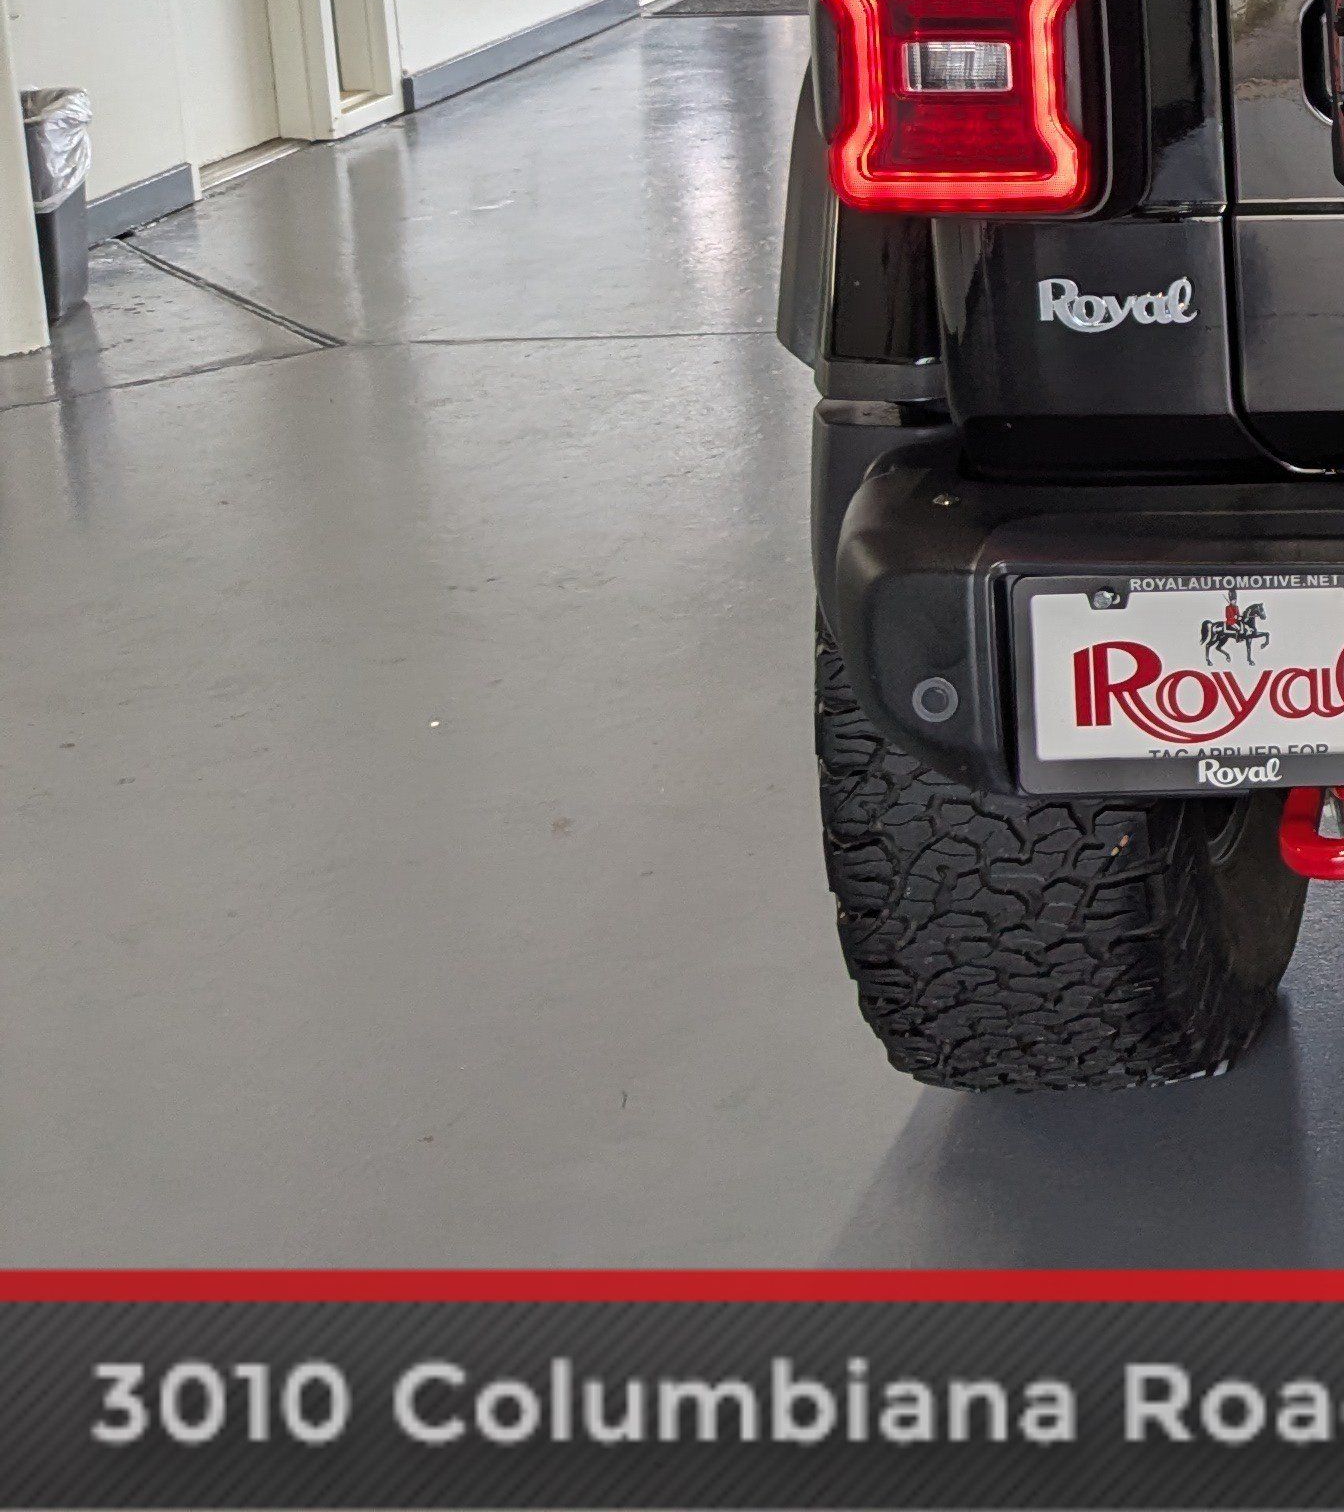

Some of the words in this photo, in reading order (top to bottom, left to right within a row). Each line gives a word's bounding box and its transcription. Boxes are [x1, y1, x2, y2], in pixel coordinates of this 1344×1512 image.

[1038, 276, 1198, 333] Royal
[1130, 574, 1339, 591] ROYALAUTOMOTIVE.NET
[1198, 757, 1283, 787] Royal
